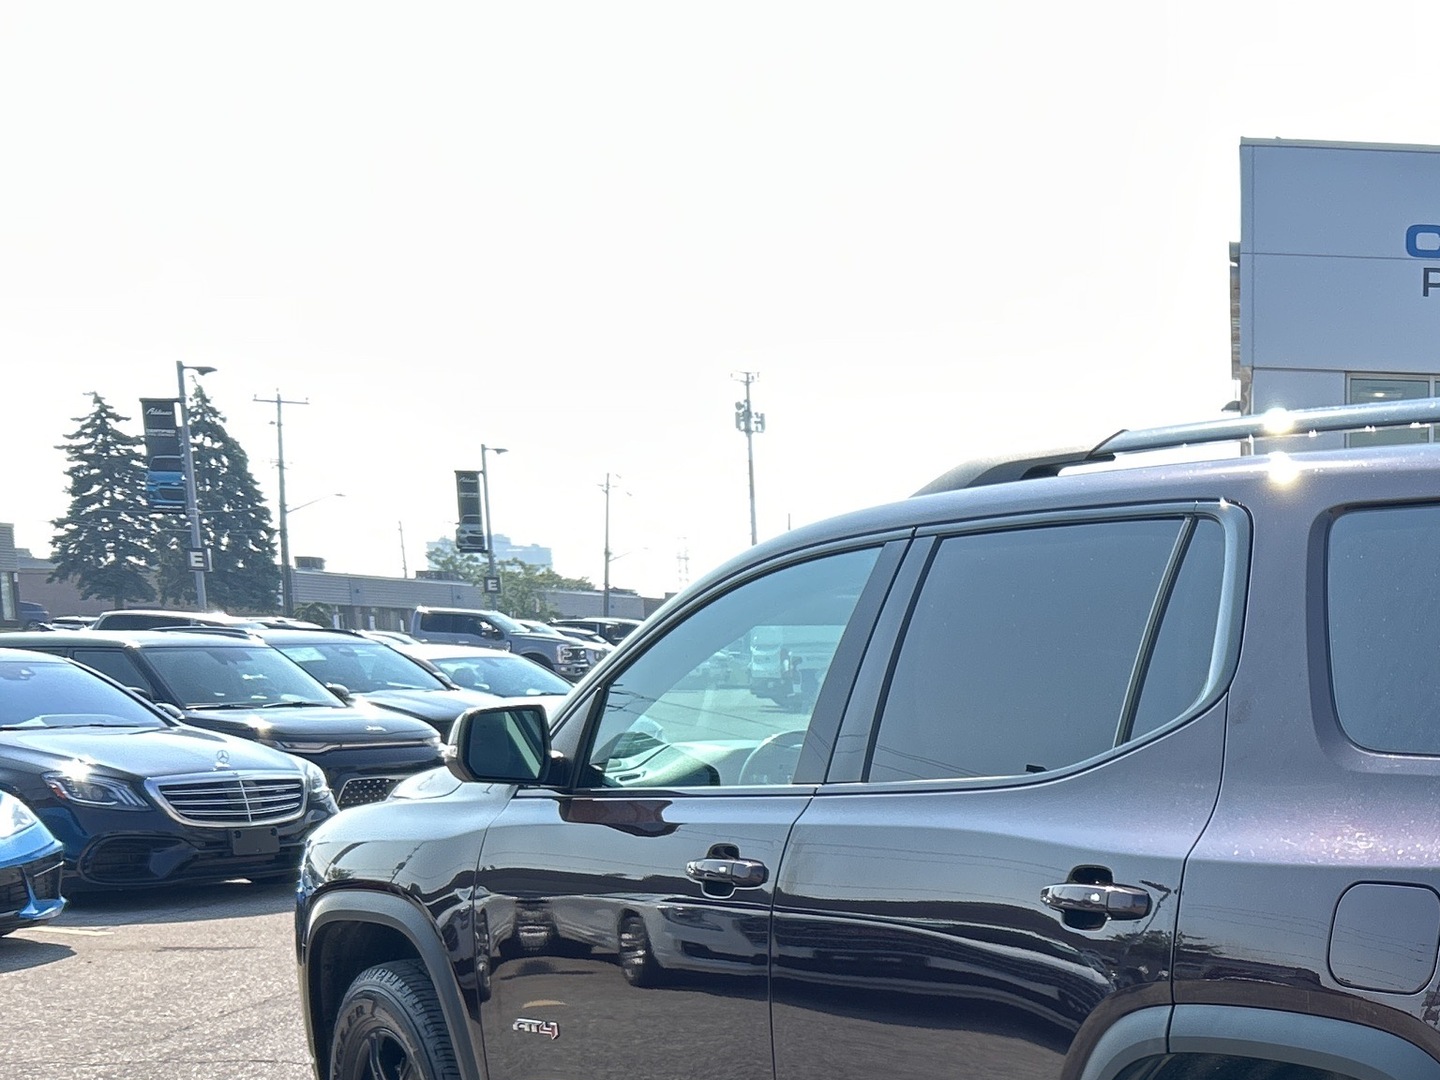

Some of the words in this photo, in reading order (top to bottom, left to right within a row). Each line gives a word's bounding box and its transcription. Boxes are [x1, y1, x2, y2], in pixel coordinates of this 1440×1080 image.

[189, 551, 205, 567] E
[487, 579, 498, 591] E
[512, 1017, 560, 1040] AT4
